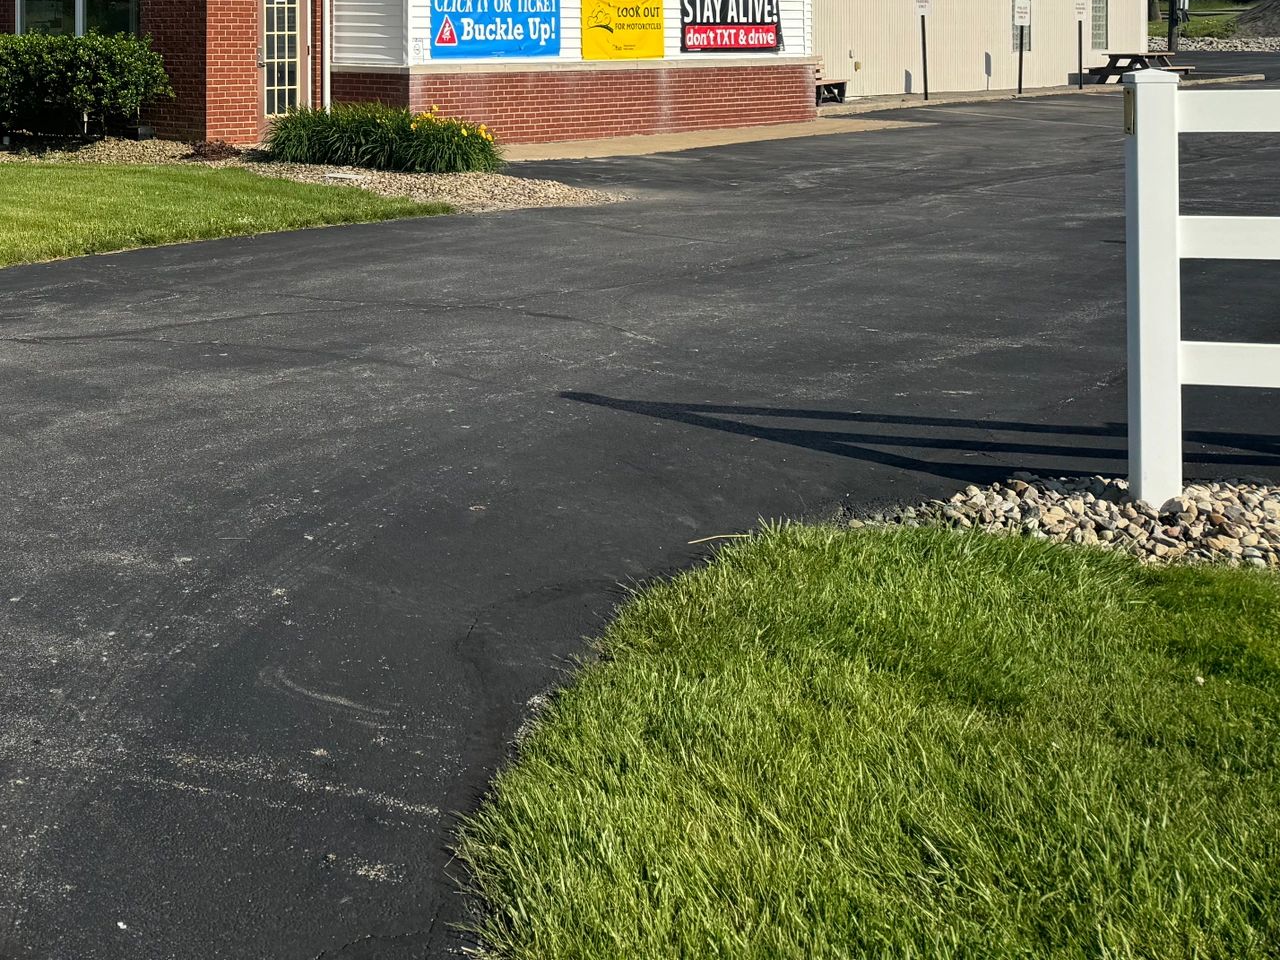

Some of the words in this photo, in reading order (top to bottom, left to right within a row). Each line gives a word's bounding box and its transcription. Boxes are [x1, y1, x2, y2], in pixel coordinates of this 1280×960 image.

[617, 5, 641, 18] LOOK
[643, 6, 661, 18] OUT
[460, 17, 525, 41] Buckle
[527, 16, 556, 46] Up!
[615, 22, 626, 30] FOR
[626, 22, 662, 30] MOTORCYCLES
[686, 29, 716, 46] don't
[715, 28, 737, 46] TXT
[738, 29, 747, 45] &
[748, 28, 775, 45] drive
